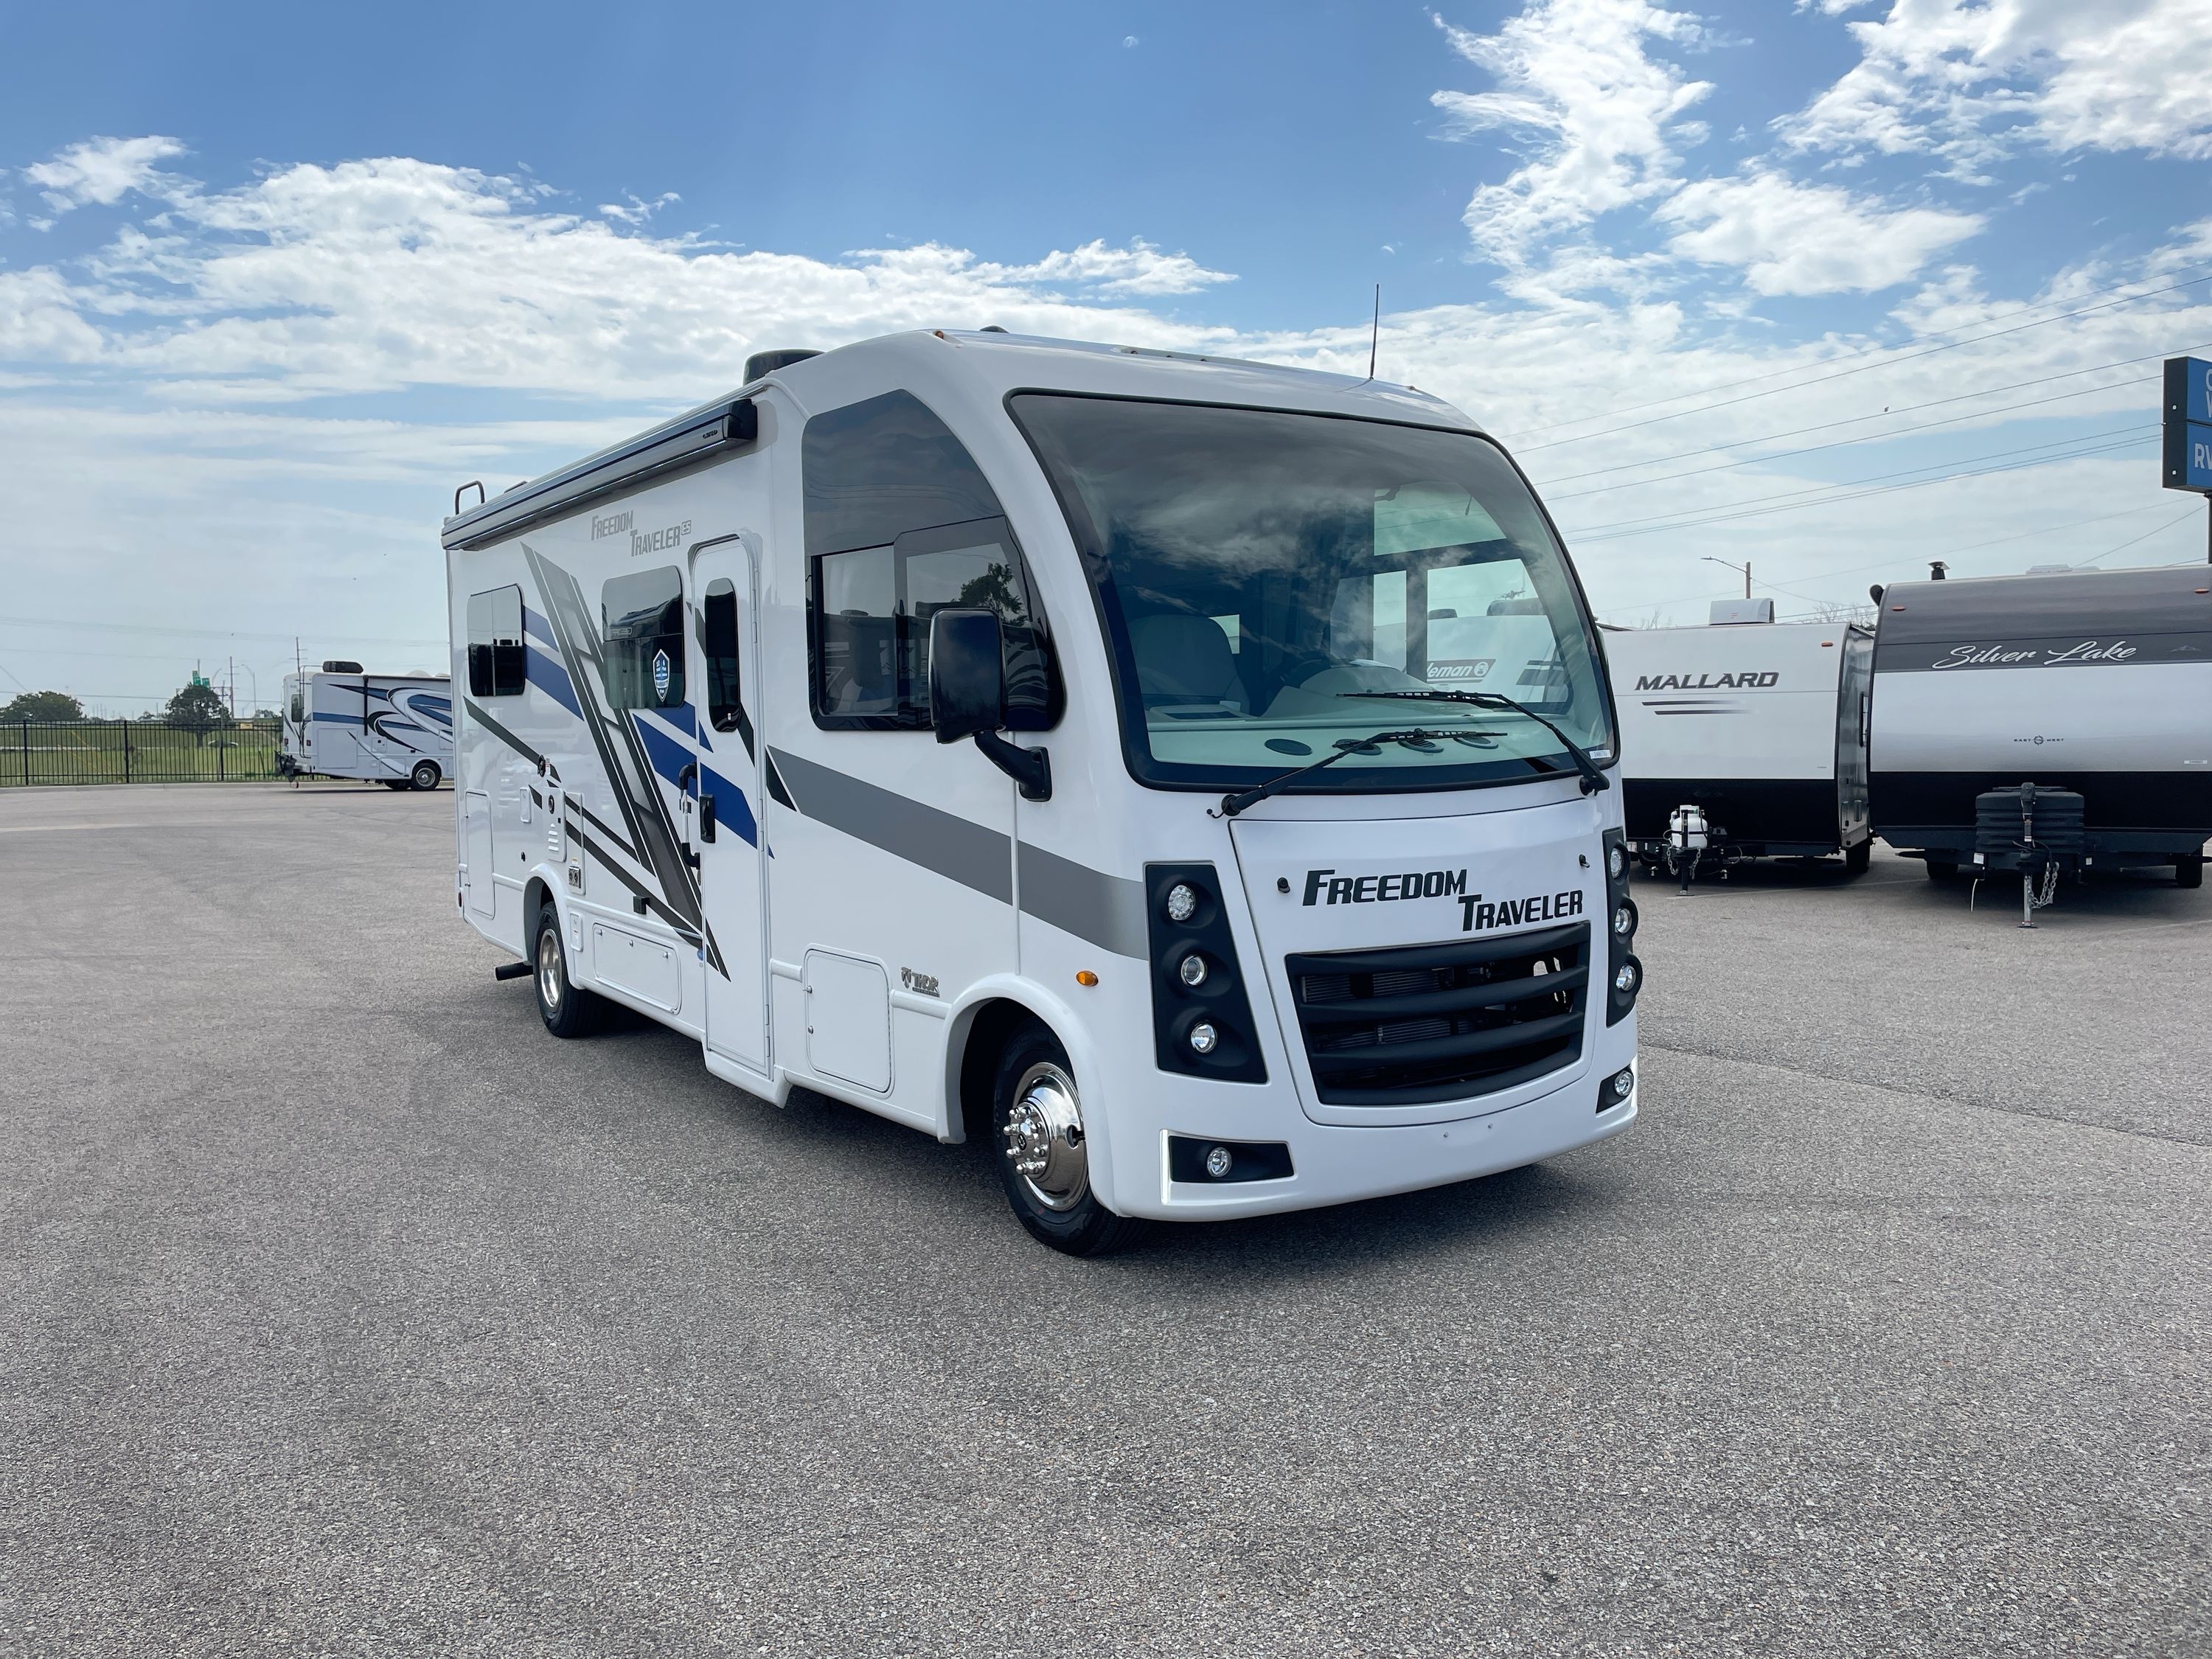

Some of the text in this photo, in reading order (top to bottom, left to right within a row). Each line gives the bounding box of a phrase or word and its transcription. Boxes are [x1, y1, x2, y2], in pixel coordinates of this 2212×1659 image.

[591, 510, 633, 540] FREEDOM
[630, 529, 681, 557] TRAVELER
[1932, 641, 2137, 669] Silver Lake
[1634, 672, 1780, 690] MALLARD
[1302, 869, 1467, 906] FREEDOM
[1457, 889, 1583, 932] TRAVELER
[911, 972, 939, 993] THOR
